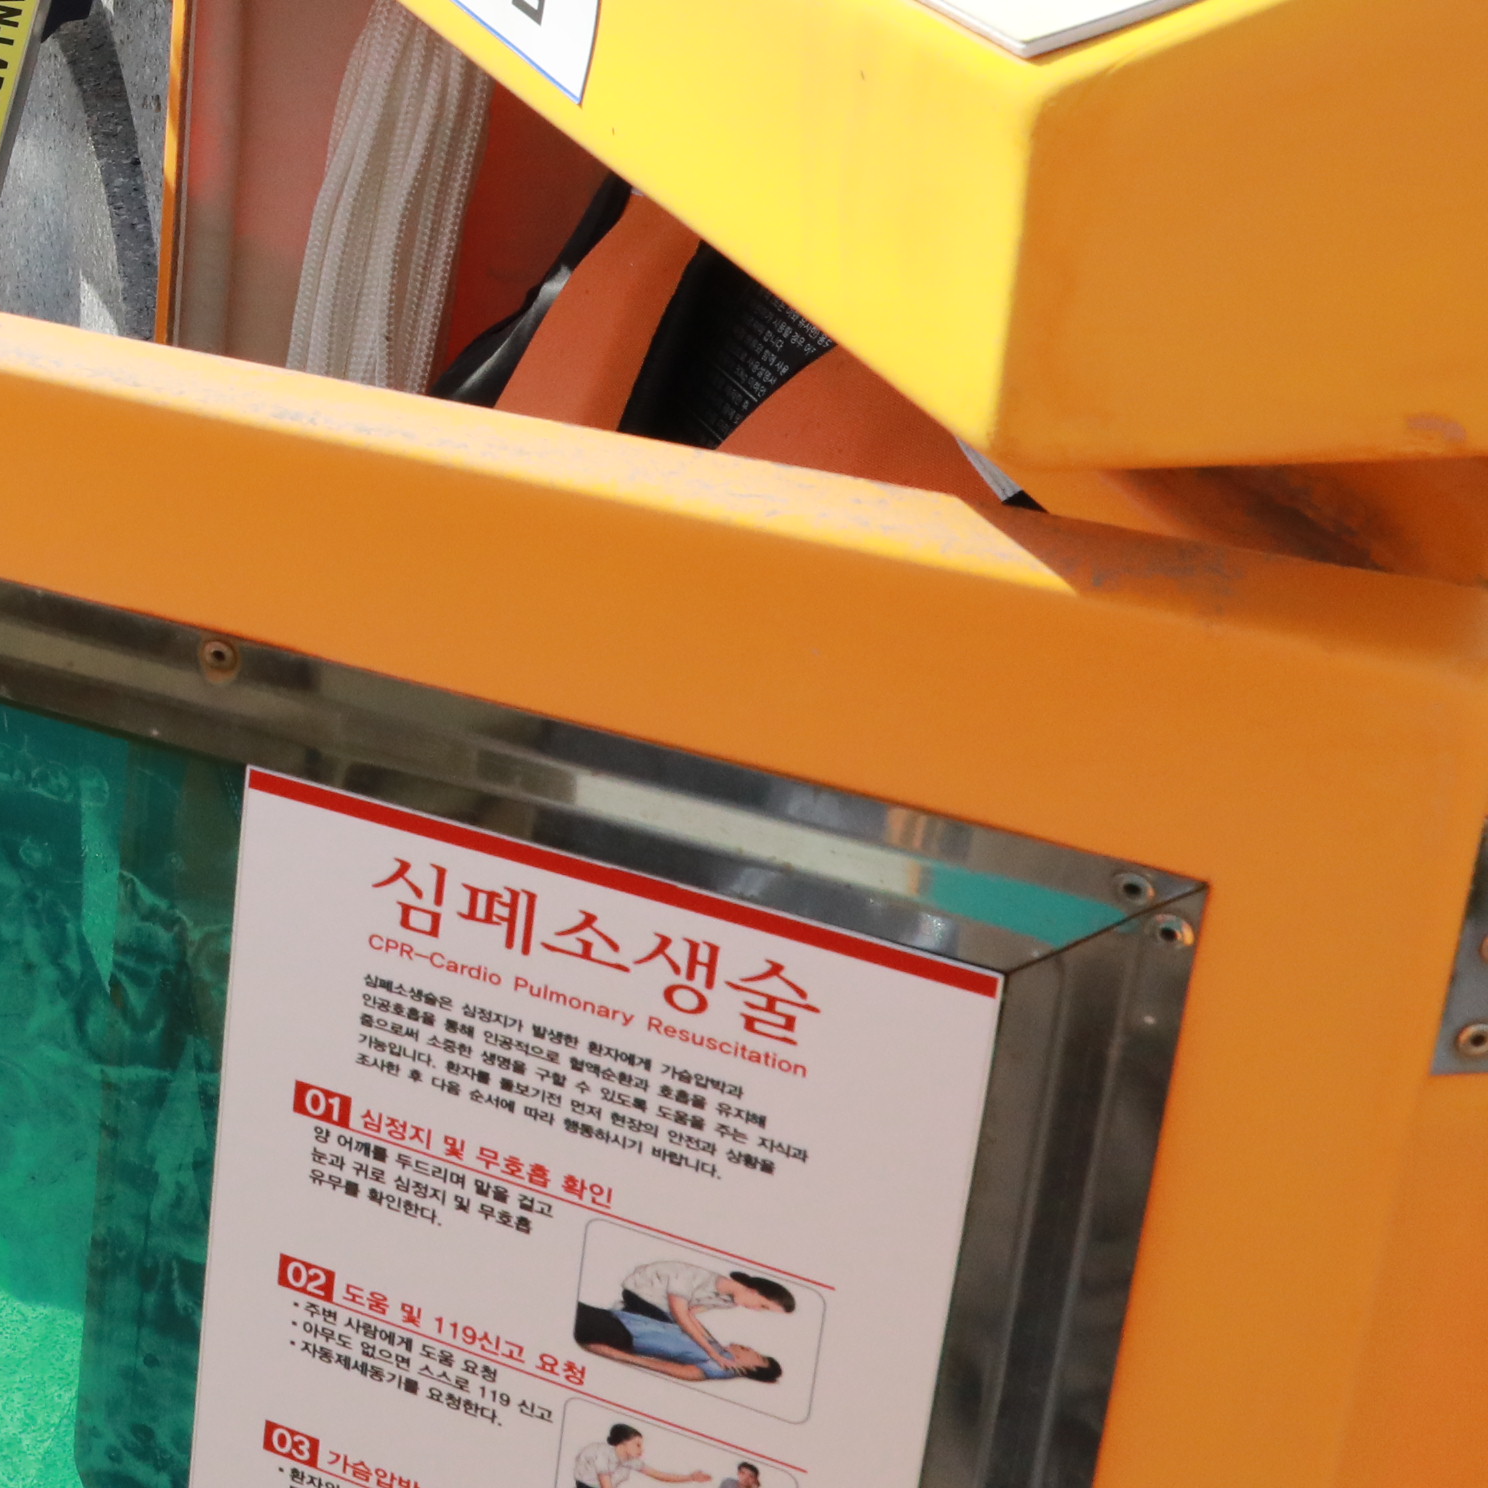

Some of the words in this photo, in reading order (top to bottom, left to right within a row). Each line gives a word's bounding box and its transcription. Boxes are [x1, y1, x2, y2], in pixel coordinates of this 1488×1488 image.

[371, 855, 823, 1048] 심폐소생술
[362, 993, 436, 1027] 인공호흡을
[483, 1030, 561, 1064] 인공적으로
[569, 1056, 649, 1093] 혈액순환과
[657, 1083, 707, 1111] 호흡을
[716, 1102, 768, 1130] 유지해
[363, 974, 454, 1012] 심폐소생술은
[461, 1003, 524, 1033] 심정지가
[532, 1022, 579, 1050] 발생한
[587, 1040, 652, 1072] 환자에게
[660, 1063, 744, 1100] 가슴압박과
[514, 976, 635, 1027] Pulmonary
[646, 1014, 808, 1079] Resuscitation
[355, 1052, 401, 1078] 조사한
[407, 1068, 423, 1084] 후
[430, 1078, 462, 1097] 다음
[468, 1088, 516, 1114] 순서에
[522, 1105, 557, 1127] 따라
[562, 1116, 643, 1155] 행동하시기
[651, 1145, 722, 1180] 바랍니다.
[359, 1013, 420, 1042] 줌으로써
[426, 1034, 473, 1058] 소중한
[480, 1050, 527, 1075] 생명을
[535, 1066, 568, 1088] 구할
[575, 1080, 591, 1095] 수
[600, 1086, 649, 1112] 있도록
[656, 1104, 707, 1132] 도움을
[714, 1122, 750, 1145] 주는
[757, 1135, 810, 1164] 지식과
[445, 1060, 491, 1086] 환자를
[570, 1099, 603, 1121] 먼저
[610, 1111, 660, 1139] 현장의
[667, 1128, 717, 1157] 안전과
[725, 1149, 777, 1175] 상황을
[303, 1088, 344, 1124] 01
[359, 1109, 433, 1150] 심정지
[443, 1135, 467, 1162] 및
[476, 1145, 553, 1190] 무호흡
[561, 1172, 614, 1211] 확인
[309, 1168, 361, 1199] 유무를
[367, 1186, 444, 1228] 확인한다.
[310, 1146, 346, 1172] 눈과
[352, 1159, 387, 1185] 귀로
[393, 1174, 448, 1206] 심정지
[453, 1192, 472, 1214] 및
[476, 1202, 534, 1235] 무호흡
[312, 1124, 331, 1145] 양
[337, 1131, 390, 1163] 어깨를
[394, 1151, 468, 1189] 두드리며
[473, 1177, 512, 1205] 말을
[516, 1191, 556, 1219] 걸고
[286, 1260, 327, 1296] 02
[341, 1283, 391, 1317] 도움
[400, 1301, 423, 1328] 및
[433, 1315, 527, 1365] 119신고
[534, 1351, 588, 1387] 요청
[302, 1320, 354, 1352] 아무도
[359, 1340, 412, 1372] 없으면
[417, 1362, 472, 1394] 스스로
[477, 1385, 511, 1408] 119
[517, 1396, 555, 1424] 신고
[304, 1300, 339, 1325] 주변
[343, 1316, 414, 1354] 사람에게
[419, 1343, 457, 1369] 도움
[460, 1357, 499, 1384] 요청
[300, 1339, 420, 1397] 자동제세동기를
[425, 1385, 504, 1428] 요청한다.
[271, 1427, 312, 1461] 03
